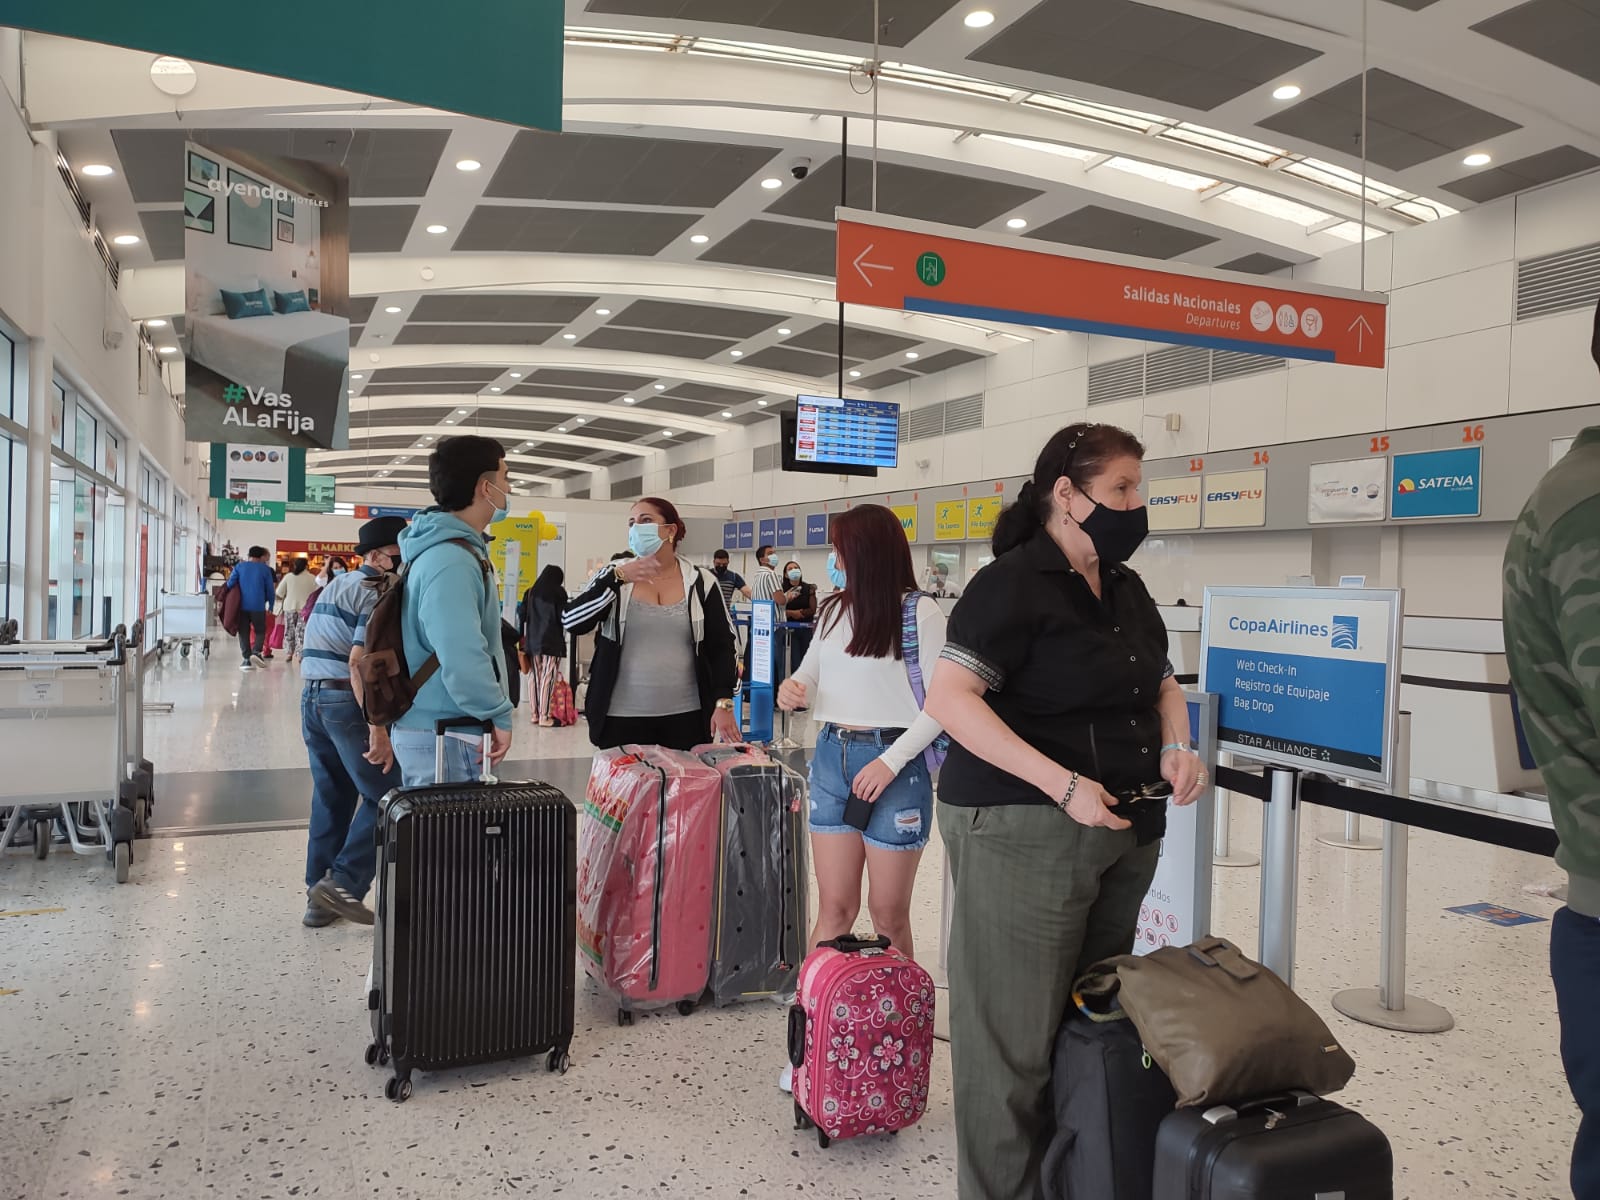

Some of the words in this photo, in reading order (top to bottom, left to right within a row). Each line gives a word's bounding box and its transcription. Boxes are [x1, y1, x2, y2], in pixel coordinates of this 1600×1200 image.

[207, 178, 288, 202] ayenda
[290, 196, 329, 208] HOTELES
[1123, 285, 1171, 305] Salidas
[1173, 291, 1241, 314] Nacionales
[1185, 312, 1241, 330] Departures
[222, 383, 293, 408] #Vas
[222, 406, 315, 435] ALaFija
[1462, 425, 1484, 443] 16
[1369, 436, 1390, 453] 15
[1418, 474, 1474, 489] SATENA
[1150, 494, 1198, 506] EASYFLY
[1207, 489, 1262, 502] EASYFLY
[308, 543, 318, 552] EL
[321, 543, 356, 552] MARKE
[1229, 616, 1329, 637] CopaAirlines
[1236, 659, 1255, 673] Web
[1257, 661, 1297, 677] Check-In
[1235, 677, 1271, 693] Registro
[1273, 683, 1284, 695] de
[1287, 684, 1330, 702] Equipaje
[1233, 696, 1250, 711] Bag
[1252, 699, 1274, 713] Drop
[1238, 734, 1263, 748] STAR
[1265, 739, 1318, 759] ALLIANCE
[1151, 888, 1172, 904] tidos
